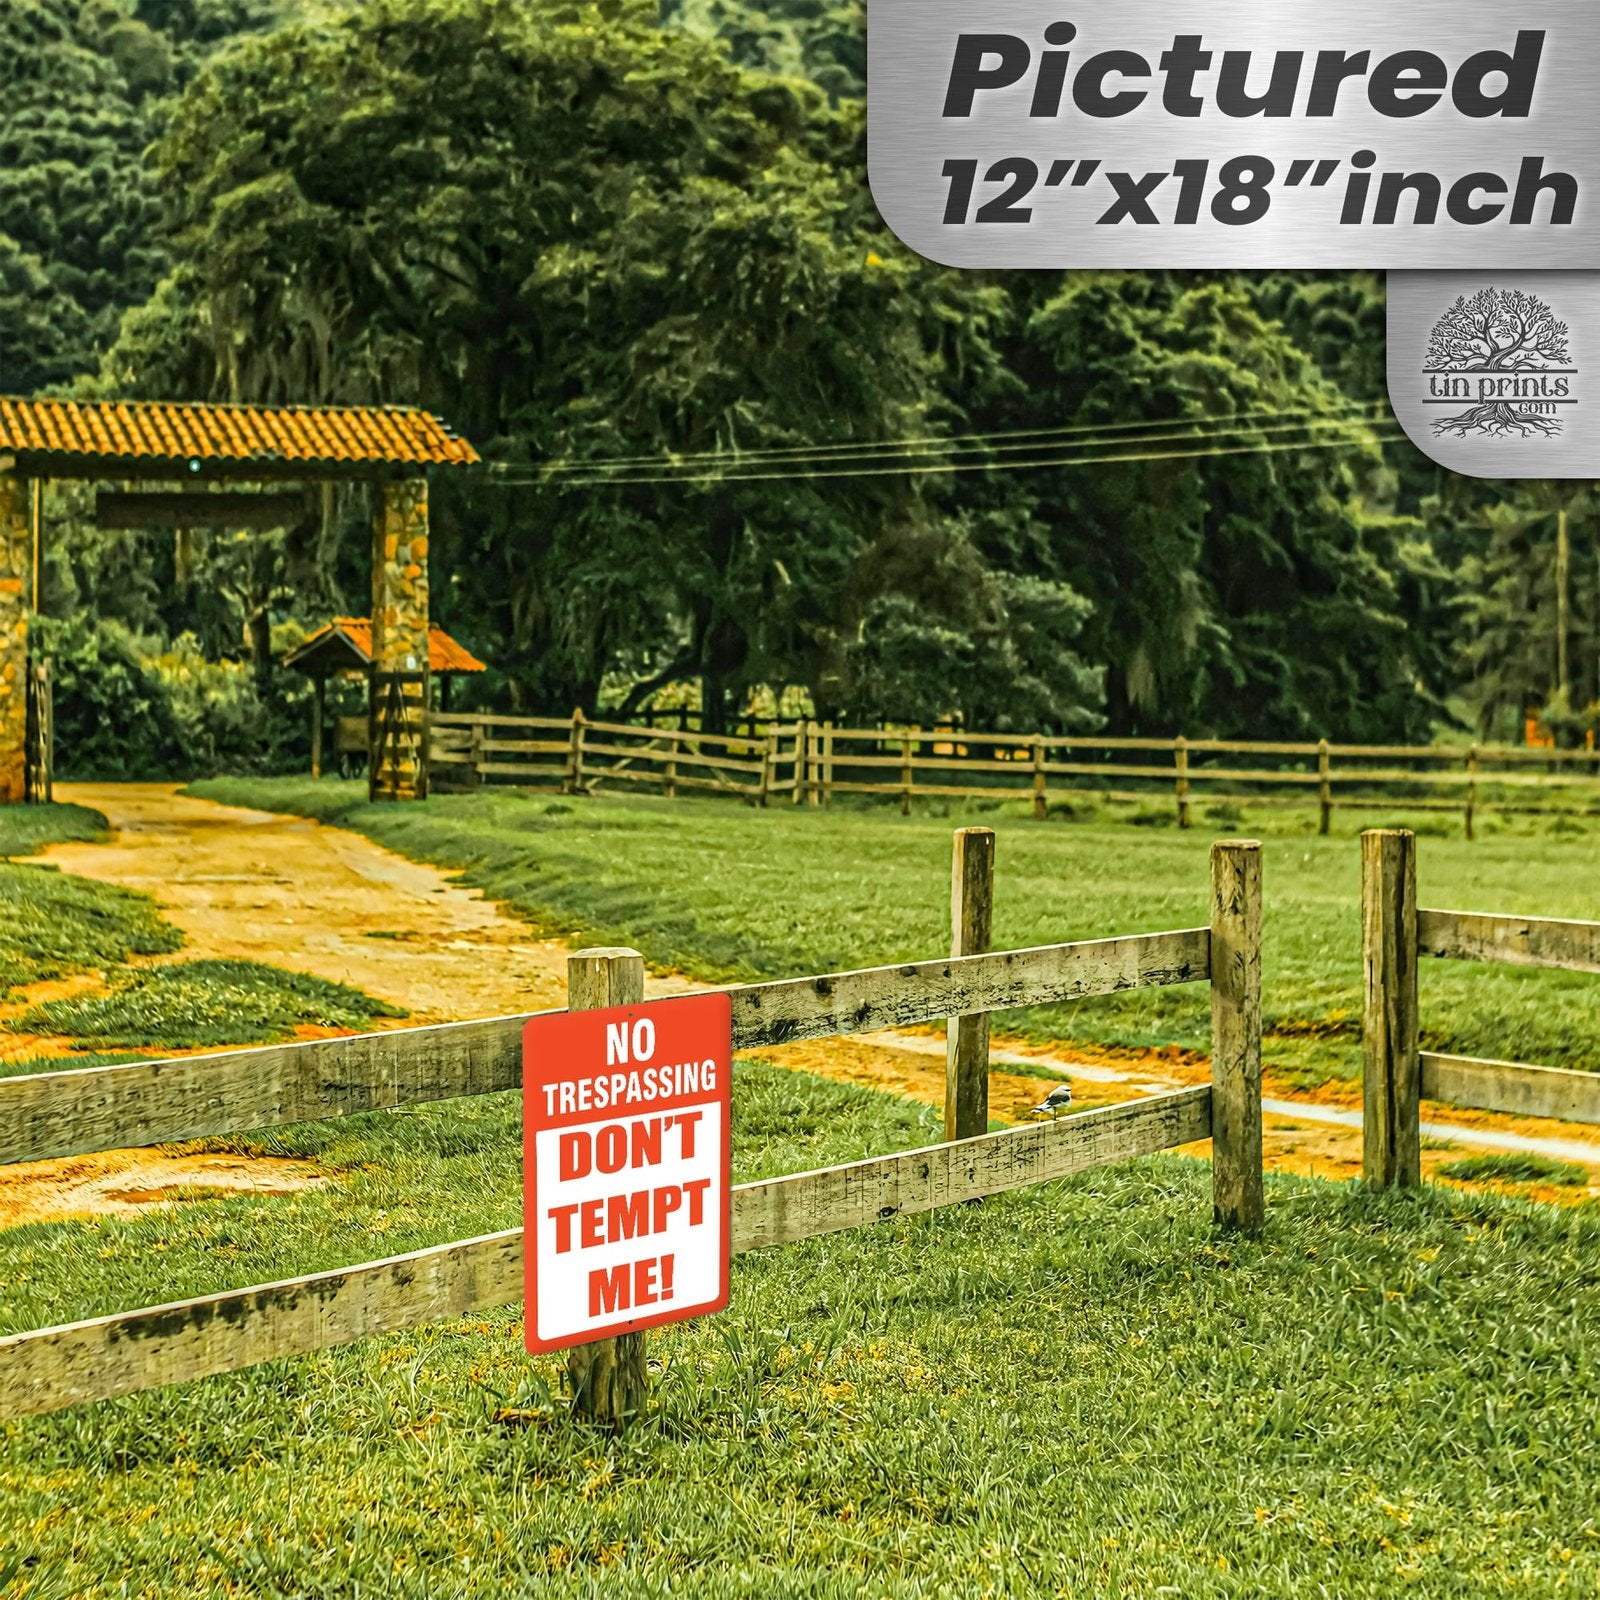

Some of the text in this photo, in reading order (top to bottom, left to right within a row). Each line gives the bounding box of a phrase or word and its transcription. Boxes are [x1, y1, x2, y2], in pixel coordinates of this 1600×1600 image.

[606, 1018, 655, 1065] NO
[542, 1059, 716, 1116] TRESPASSING
[559, 1111, 703, 1182] DON'T
[548, 1178, 711, 1254] TEMPT
[588, 1253, 675, 1318] ME!
